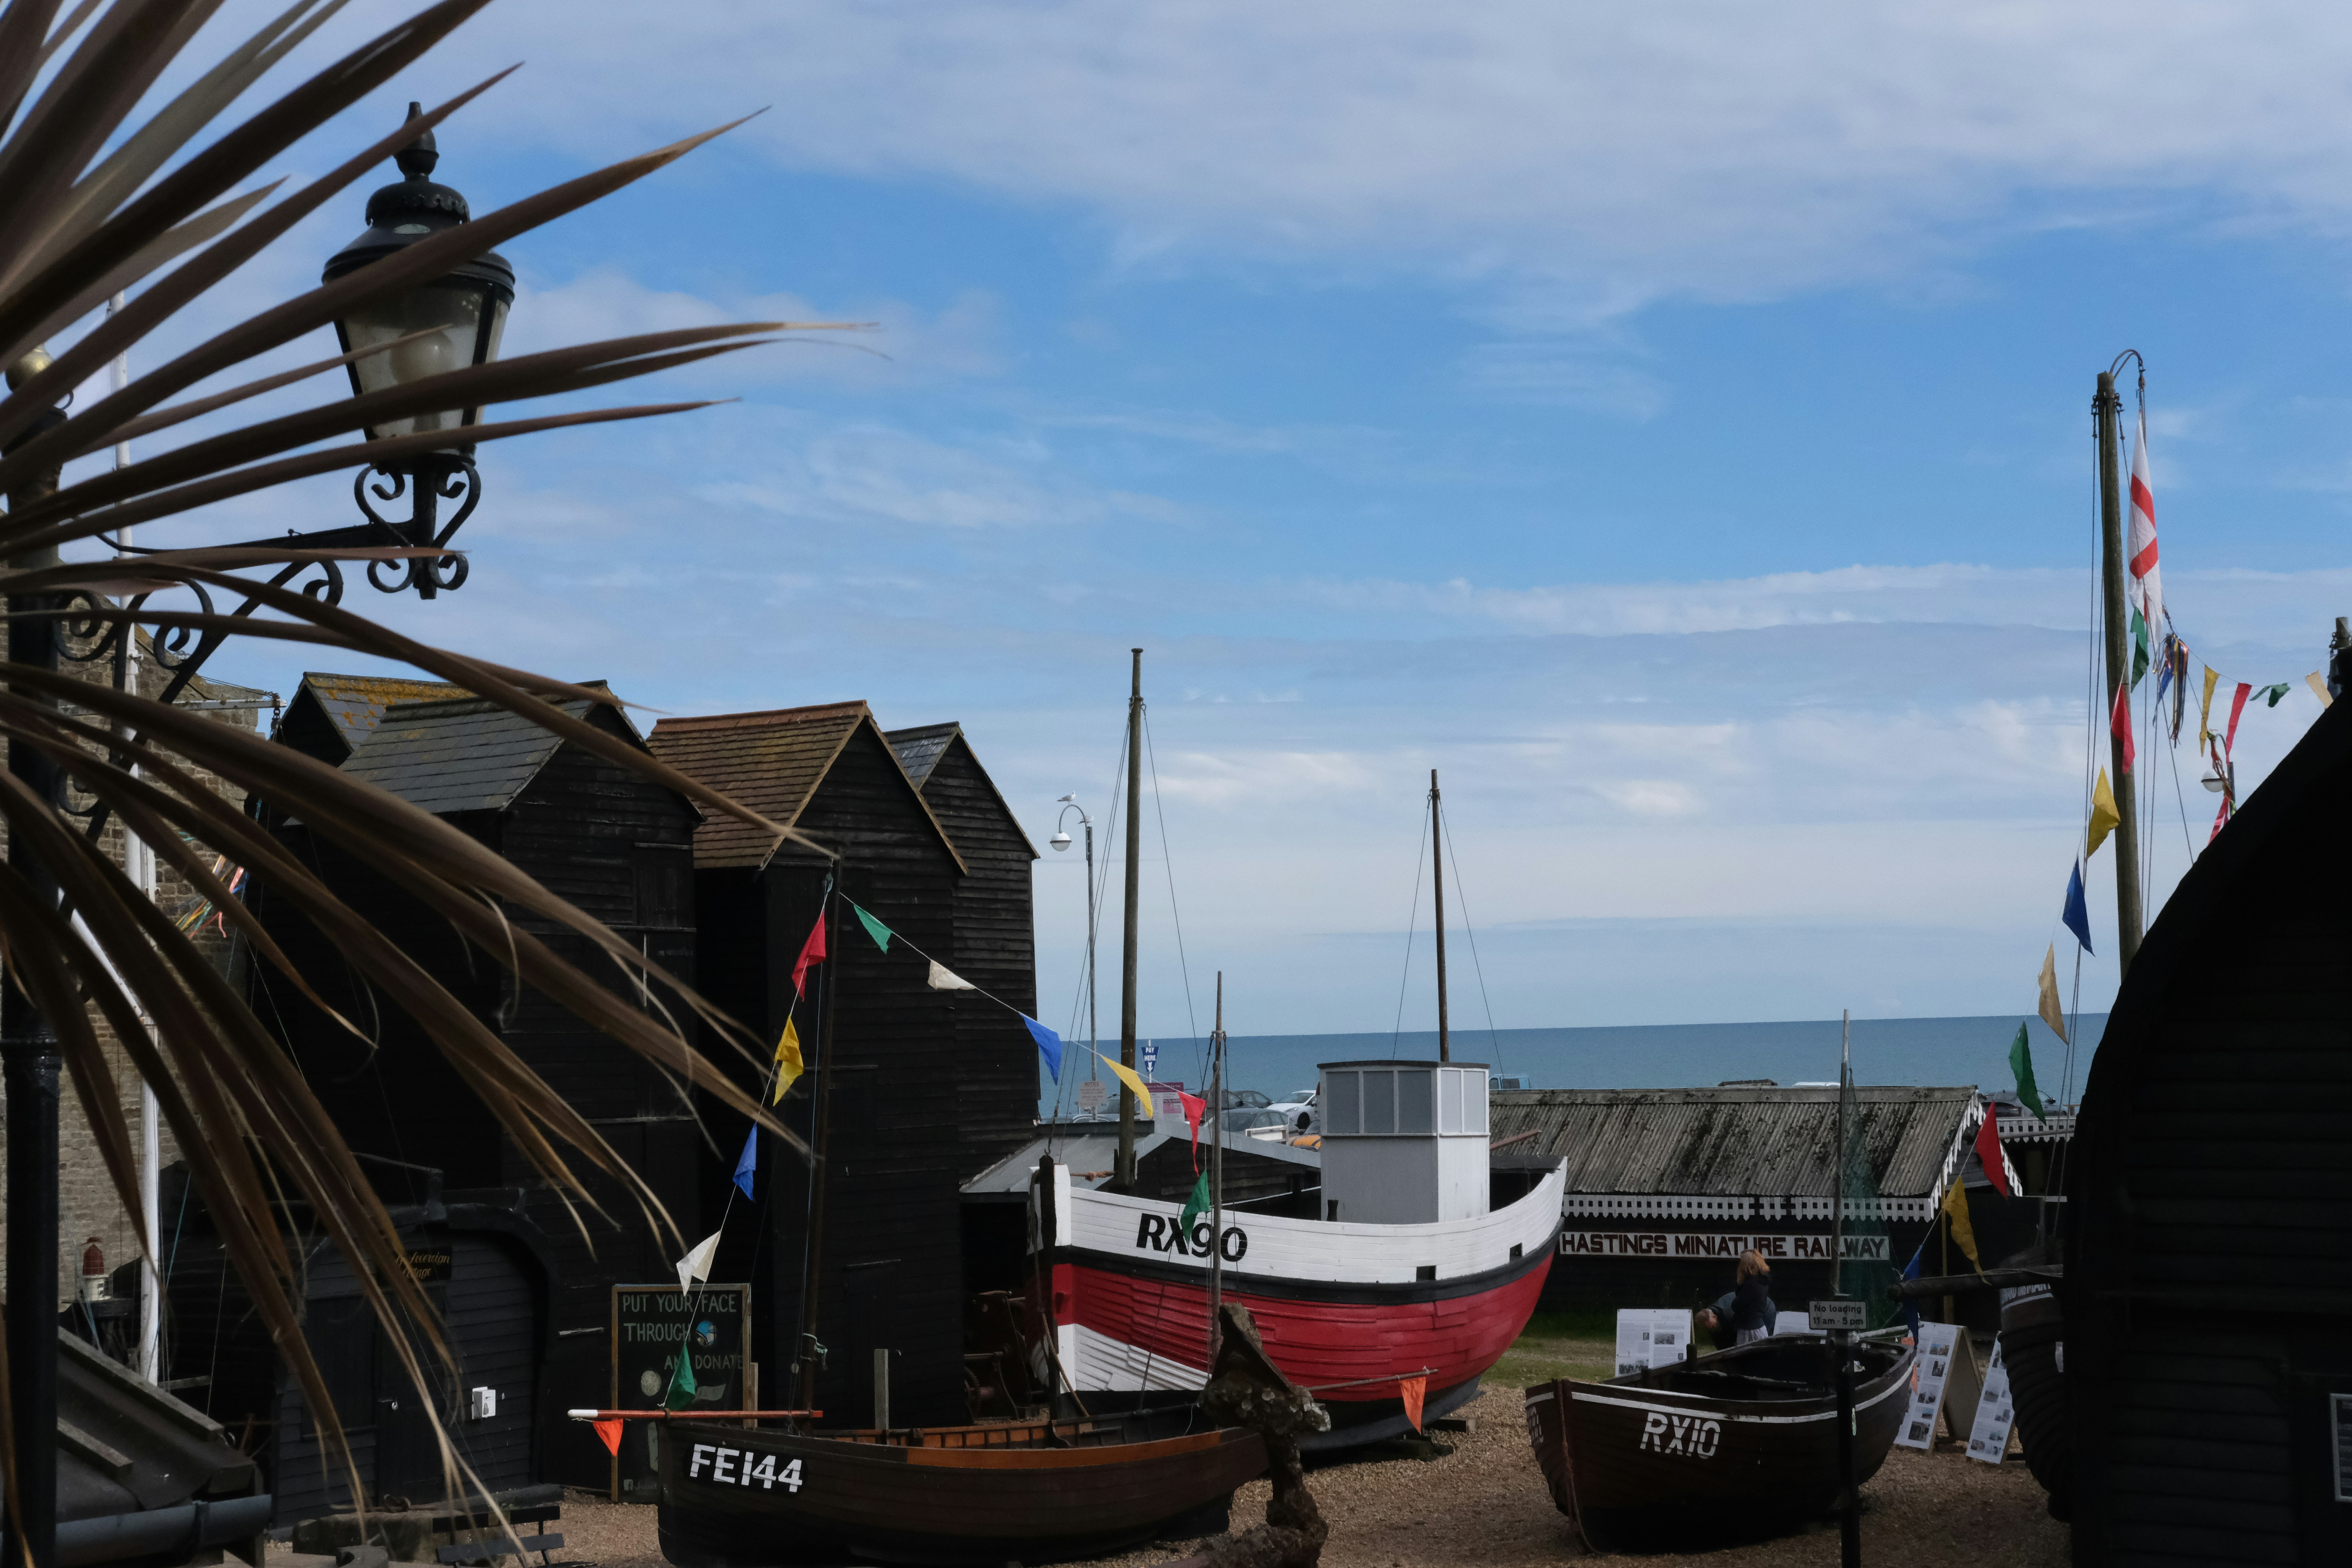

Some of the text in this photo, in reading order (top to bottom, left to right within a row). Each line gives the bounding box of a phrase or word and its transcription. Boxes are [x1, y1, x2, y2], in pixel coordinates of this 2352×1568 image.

[1136, 1213, 1248, 1262] RX90
[1562, 1233, 1886, 1257] HASTINGS MINIATURE RAIWAY
[622, 1294, 737, 1313] PUT YOUR FACE
[1829, 1304, 1862, 1314] loading
[623, 1323, 691, 1342] THROUGH
[664, 1355, 743, 1370] AN DONATE
[1640, 1412, 1721, 1459] RX10
[689, 1444, 803, 1493] FE144
